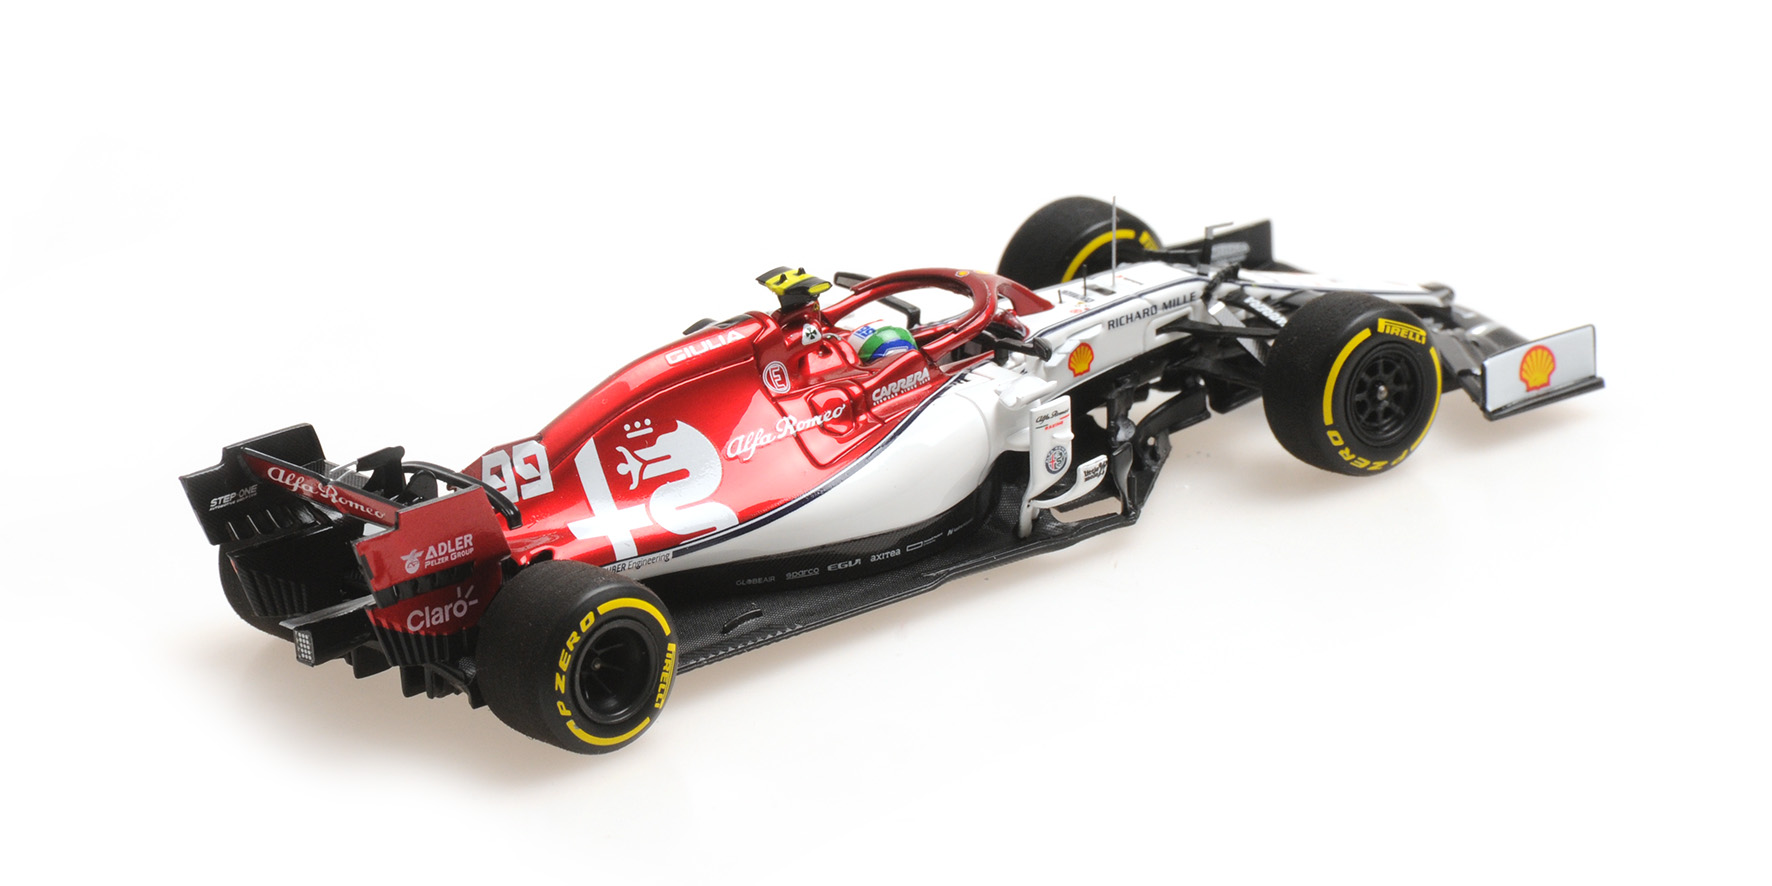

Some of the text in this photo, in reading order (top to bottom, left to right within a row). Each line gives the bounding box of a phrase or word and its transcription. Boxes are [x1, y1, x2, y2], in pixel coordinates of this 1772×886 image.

[1107, 291, 1196, 331] RICHARD MILLE
[664, 328, 746, 366] GIULIA
[1377, 317, 1427, 345] PIRELLI
[871, 366, 930, 402] CARRERA
[726, 403, 847, 462] Alfa Romeo
[1326, 430, 1389, 471] ZERO
[481, 439, 554, 503] 99
[209, 492, 237, 508] STEP
[238, 484, 259, 498] ONE
[267, 466, 386, 519] Alfa Romeo
[424, 533, 474, 561] ADLER
[424, 556, 450, 569] PELZER
[450, 547, 475, 561] GROUP
[627, 552, 671, 570] Engineering
[785, 567, 820, 580] sparco
[406, 599, 468, 632] Claro
[554, 610, 595, 716] P ZERO
[654, 642, 677, 709] PIRELLI
